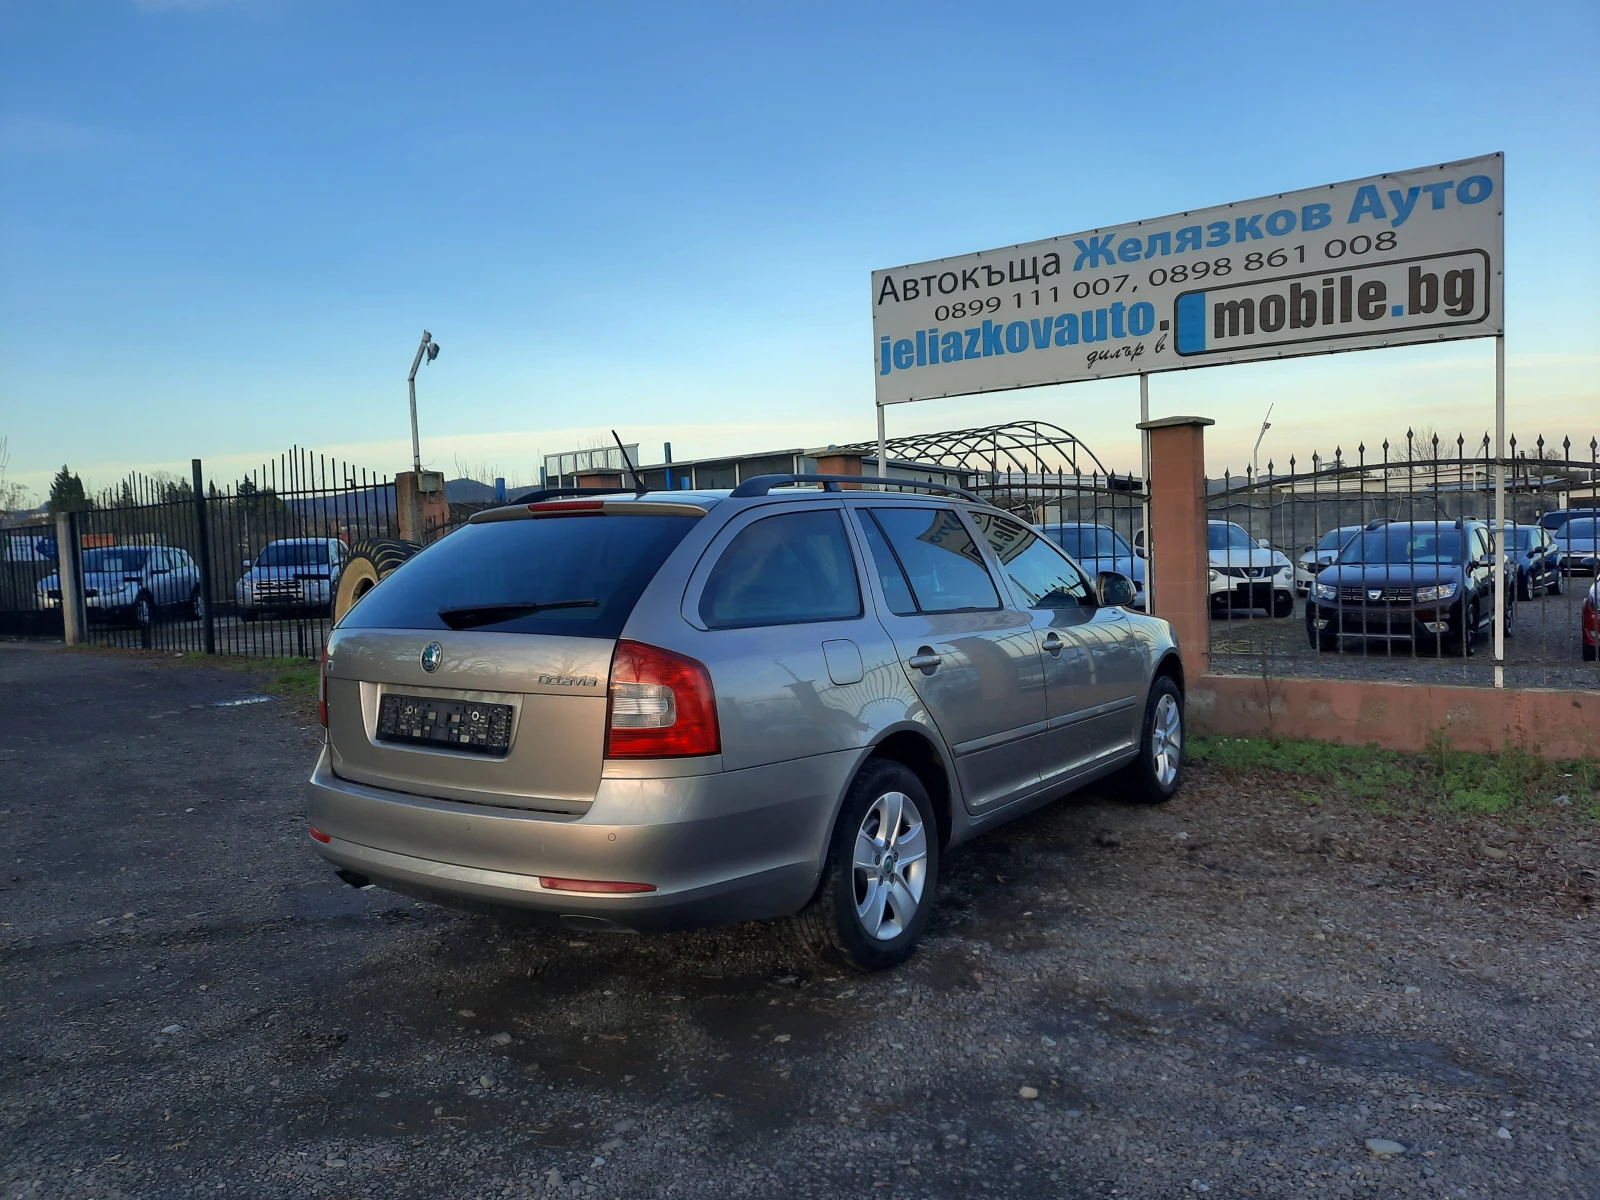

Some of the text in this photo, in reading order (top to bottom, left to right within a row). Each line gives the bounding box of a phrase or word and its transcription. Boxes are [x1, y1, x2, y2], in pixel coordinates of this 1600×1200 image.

[877, 174, 1494, 305] Автокъща Желязков Ауто
[934, 230, 1398, 322] 0899 111 007, 0898 861 008
[1213, 265, 1475, 339] mobile.bg
[537, 673, 598, 687] Octavia
